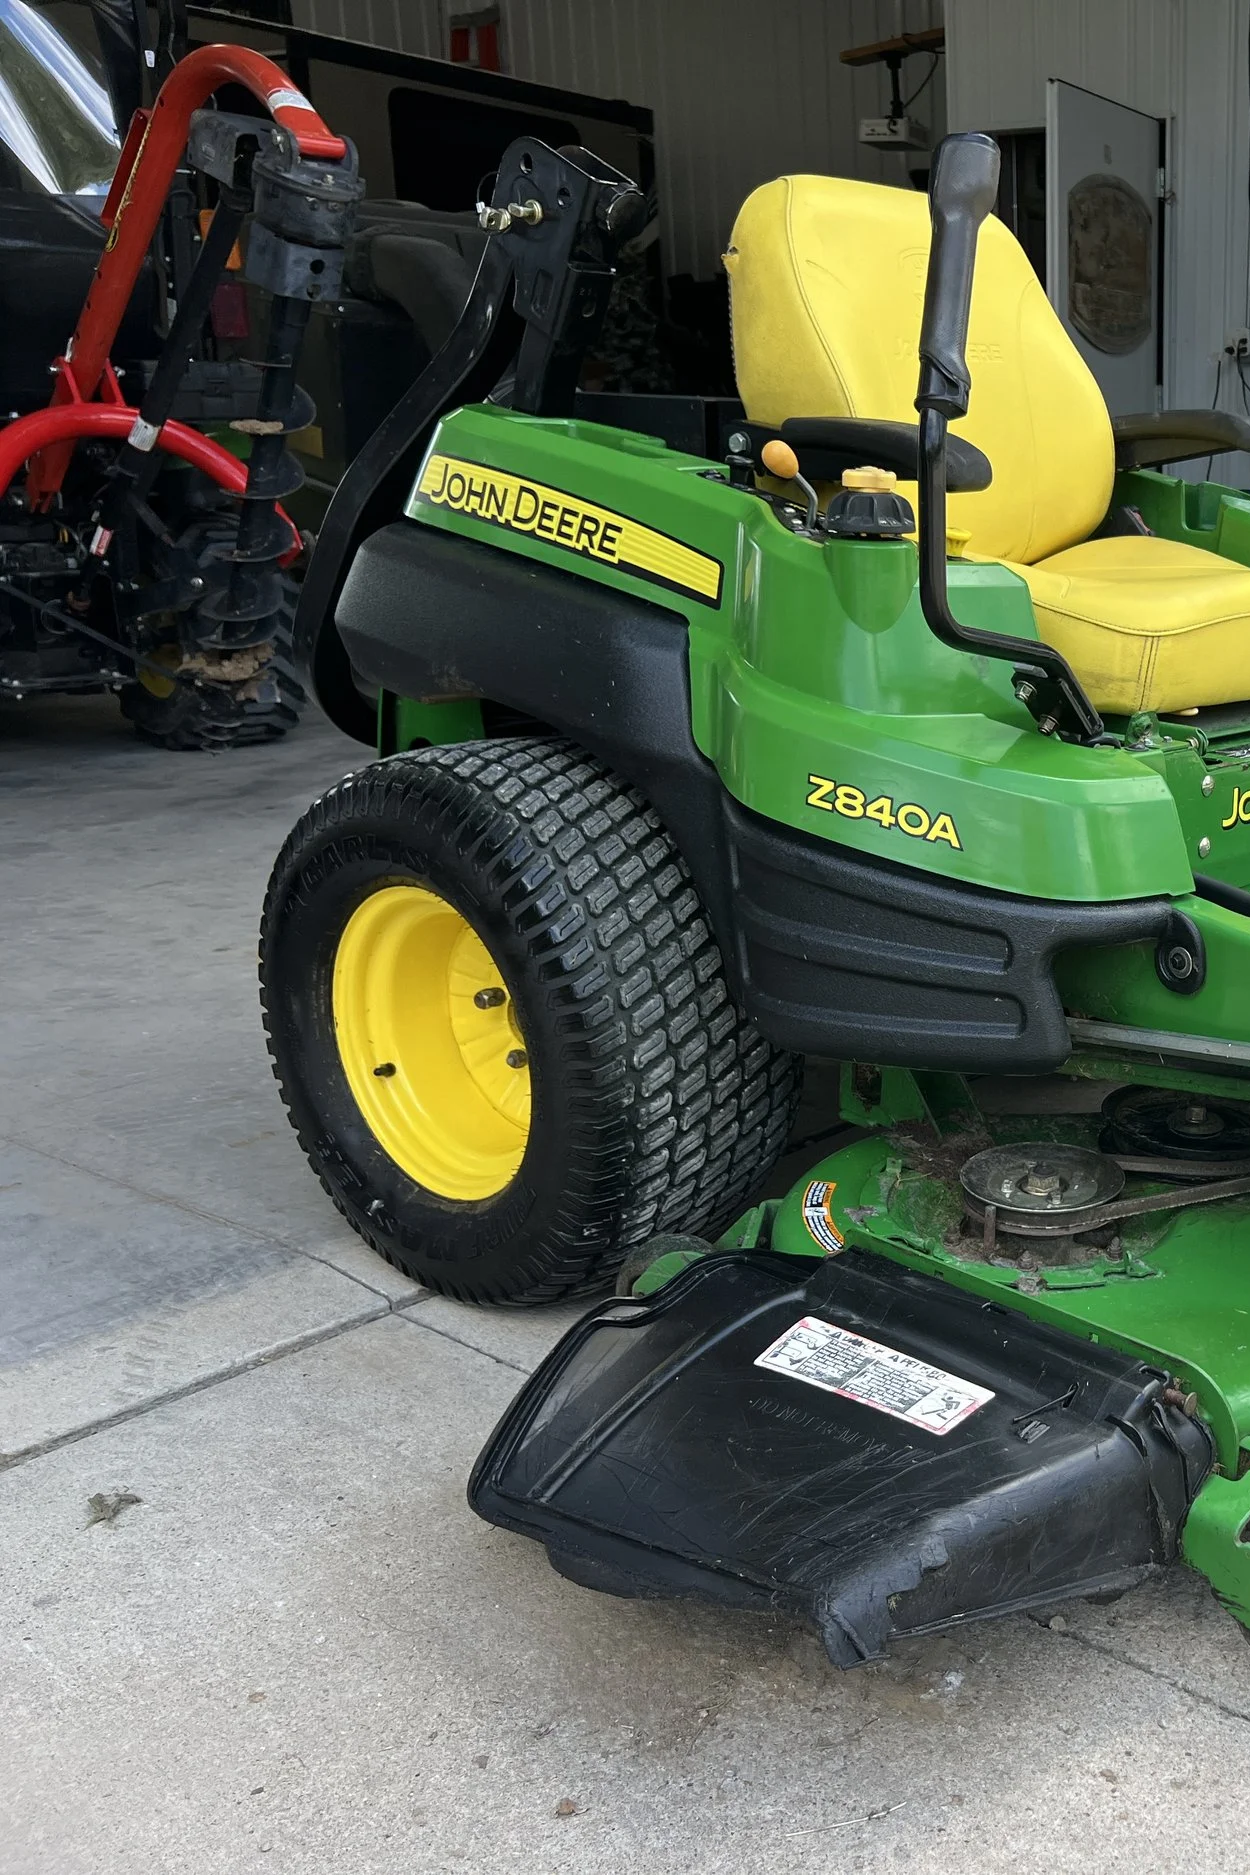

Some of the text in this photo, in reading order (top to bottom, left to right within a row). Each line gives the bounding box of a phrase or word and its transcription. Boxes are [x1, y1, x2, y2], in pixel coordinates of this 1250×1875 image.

[430, 463, 624, 558] JOHN DEERE
[806, 772, 964, 852] Z840A
